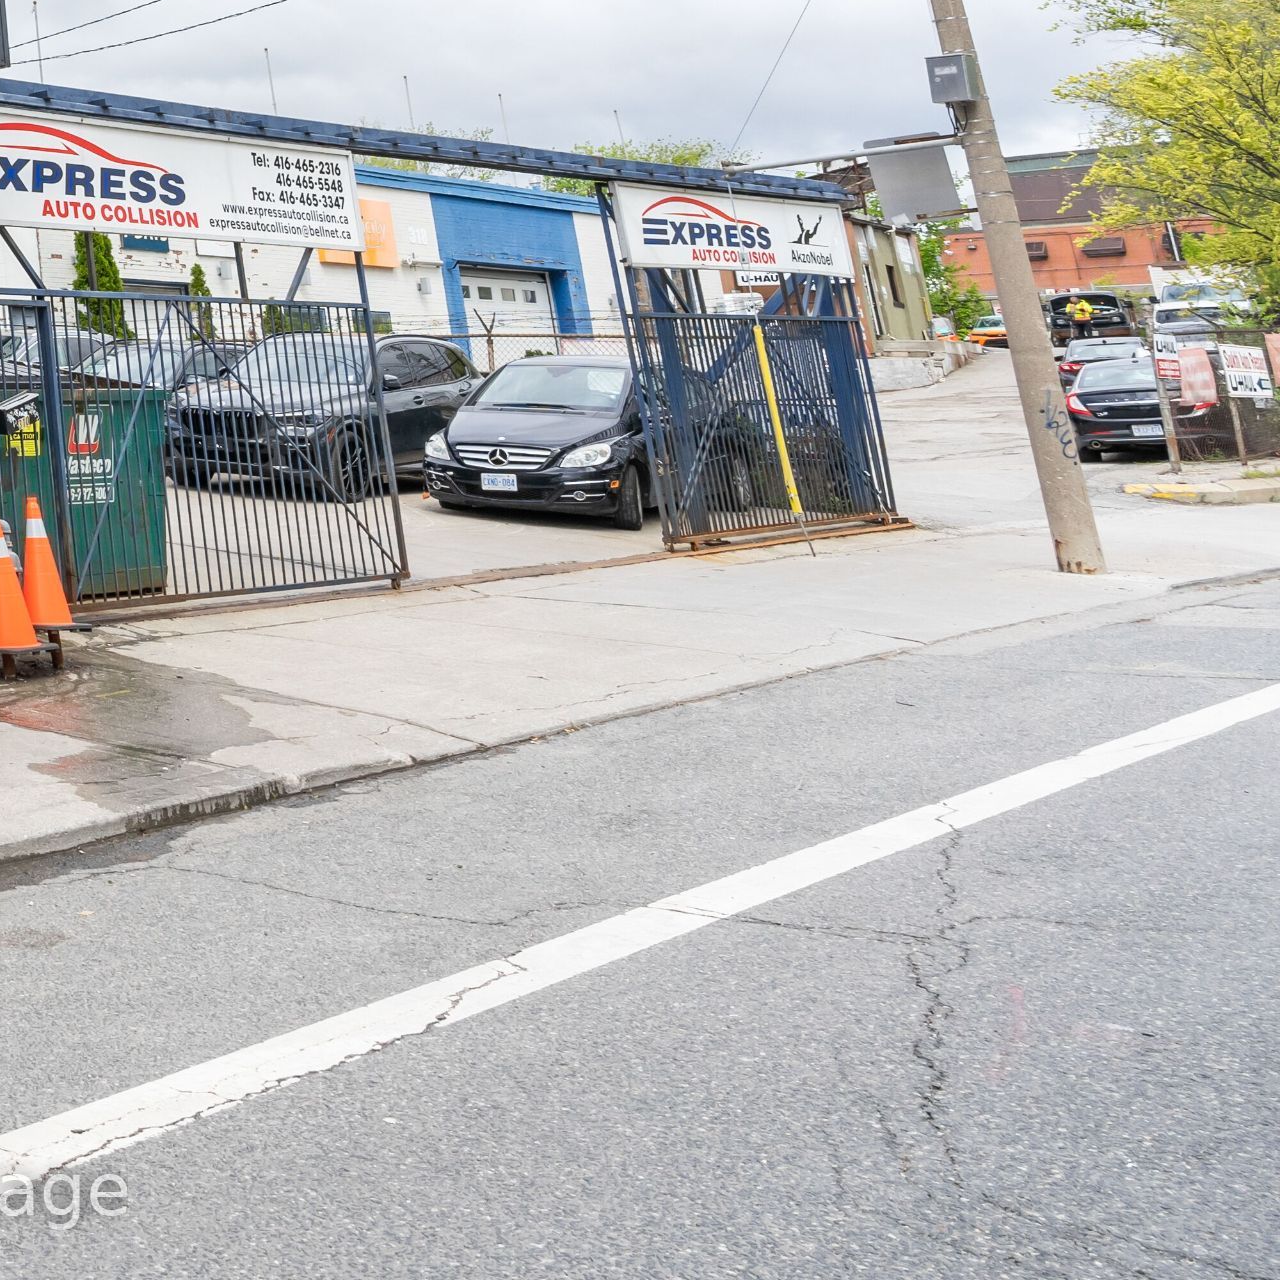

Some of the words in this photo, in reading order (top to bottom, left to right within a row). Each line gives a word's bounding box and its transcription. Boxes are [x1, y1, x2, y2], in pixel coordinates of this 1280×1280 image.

[251, 152, 270, 169] Tel:
[251, 187, 276, 203] Fax:
[42, 199, 96, 222] AUTO
[100, 204, 200, 229] COLLISION
[222, 204, 349, 225] www.expressautocollision.ca
[209, 217, 352, 240] expressautocollision@bellnet.ca
[642, 217, 772, 250] EXPRESS
[692, 248, 721, 262] AUTO
[723, 249, 776, 265] COISION
[791, 249, 834, 267] AkzoNobel
[741, 274, 781, 283] U-HAU
[65, 455, 112, 475] asteco
